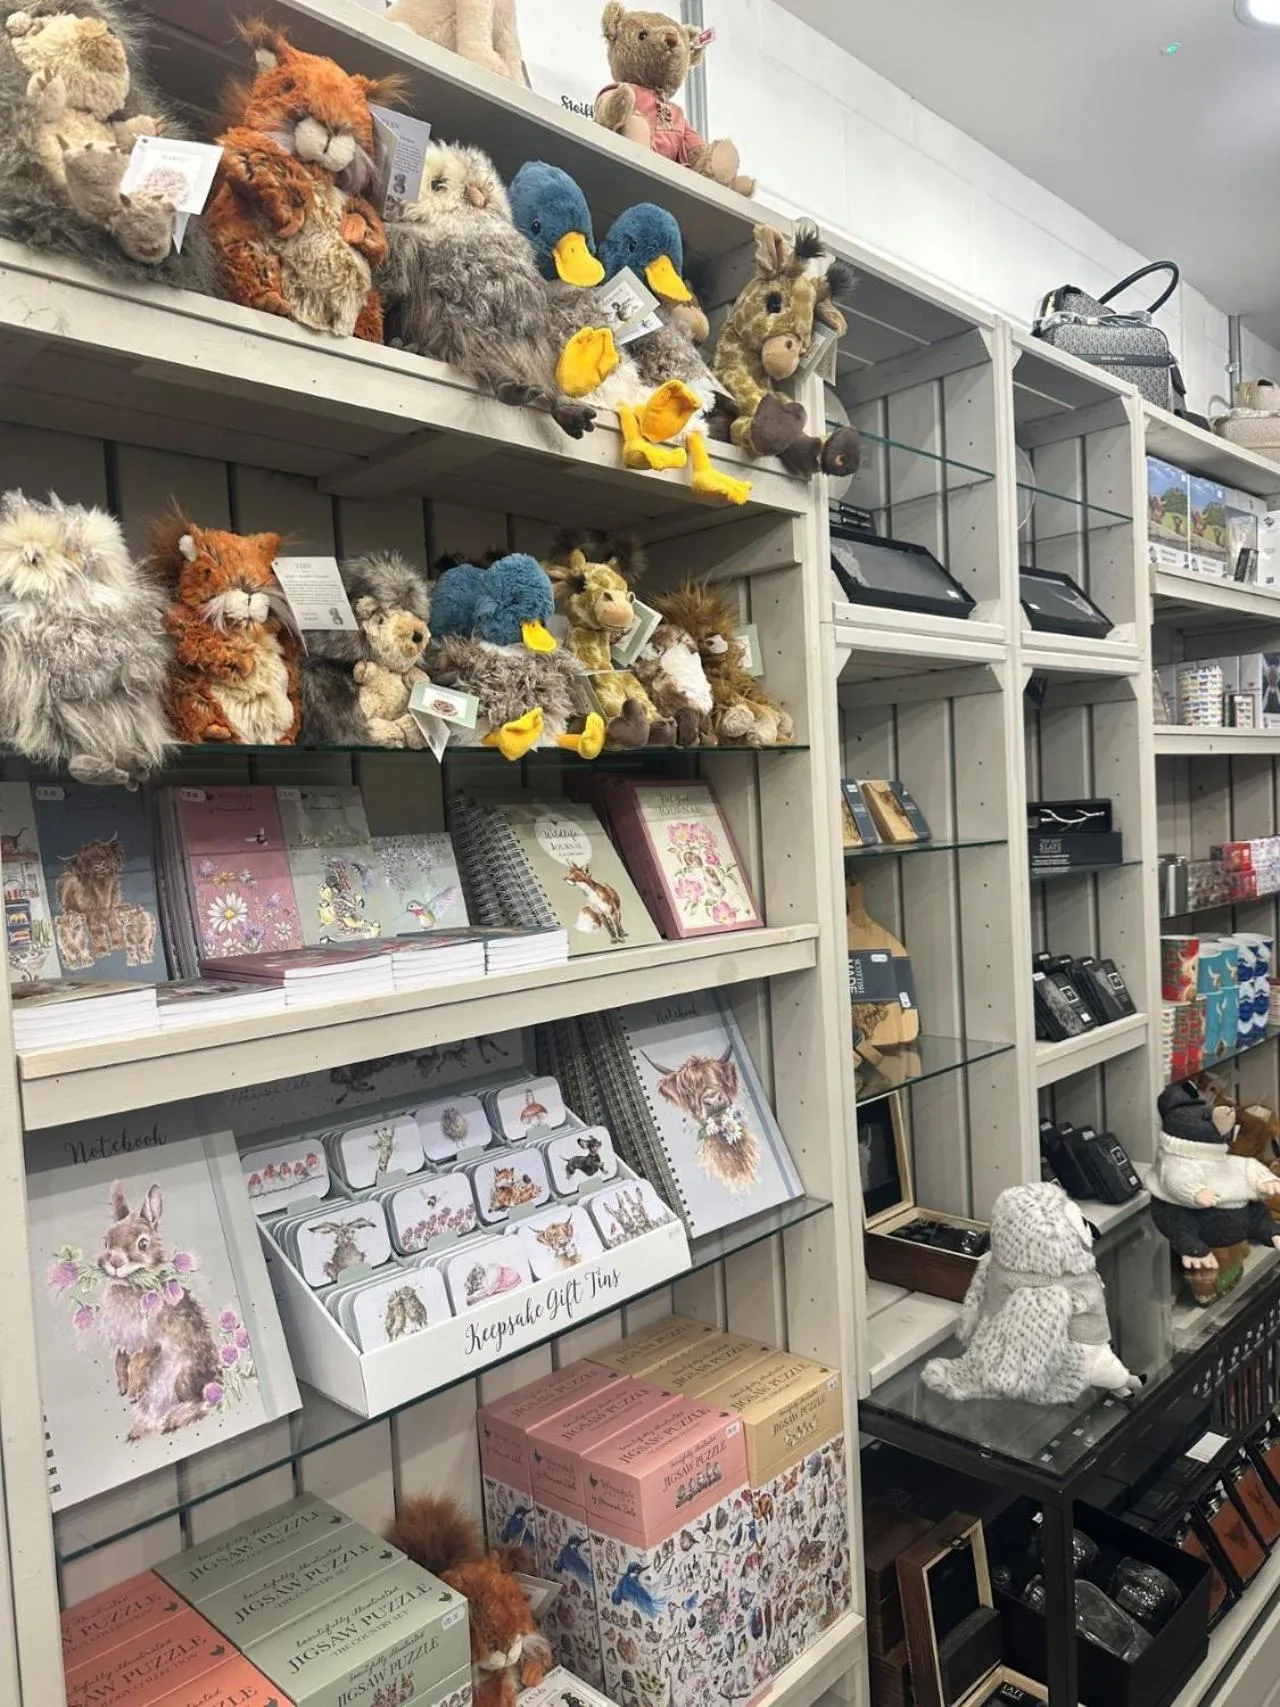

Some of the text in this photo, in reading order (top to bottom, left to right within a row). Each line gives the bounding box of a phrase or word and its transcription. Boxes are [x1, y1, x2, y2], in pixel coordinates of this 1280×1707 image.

[64, 1122, 168, 1165] Notebook
[464, 1267, 621, 1355] Keepsake Gift Tins
[731, 1385, 771, 1412] JIGSAW
[768, 1363, 810, 1387] PUZZLE
[562, 1413, 607, 1442] JIGSAW
[607, 1389, 650, 1413] PUZZLE
[618, 1436, 664, 1465] JIGSAW
[662, 1407, 712, 1435] PUZZLE
[771, 1392, 827, 1437] JIGSAW PUZZLE
[662, 1439, 728, 1493] JIGSAW PUZZLE
[189, 1509, 326, 1584] JIGSAW PUZZLE
[233, 1542, 375, 1625] JIGSAW PUZZLE
[242, 1571, 296, 1599] beautifully
[80, 1592, 162, 1637] PUZZLE
[287, 1582, 433, 1675] JIGSAW PUZZLE
[296, 1584, 400, 1648] beautifully illustrated
[330, 1608, 411, 1657] THE COUNTRY SET
[122, 1635, 208, 1684] PUZZLE
[337, 1634, 440, 1707] JIGSAW PUZZLE
